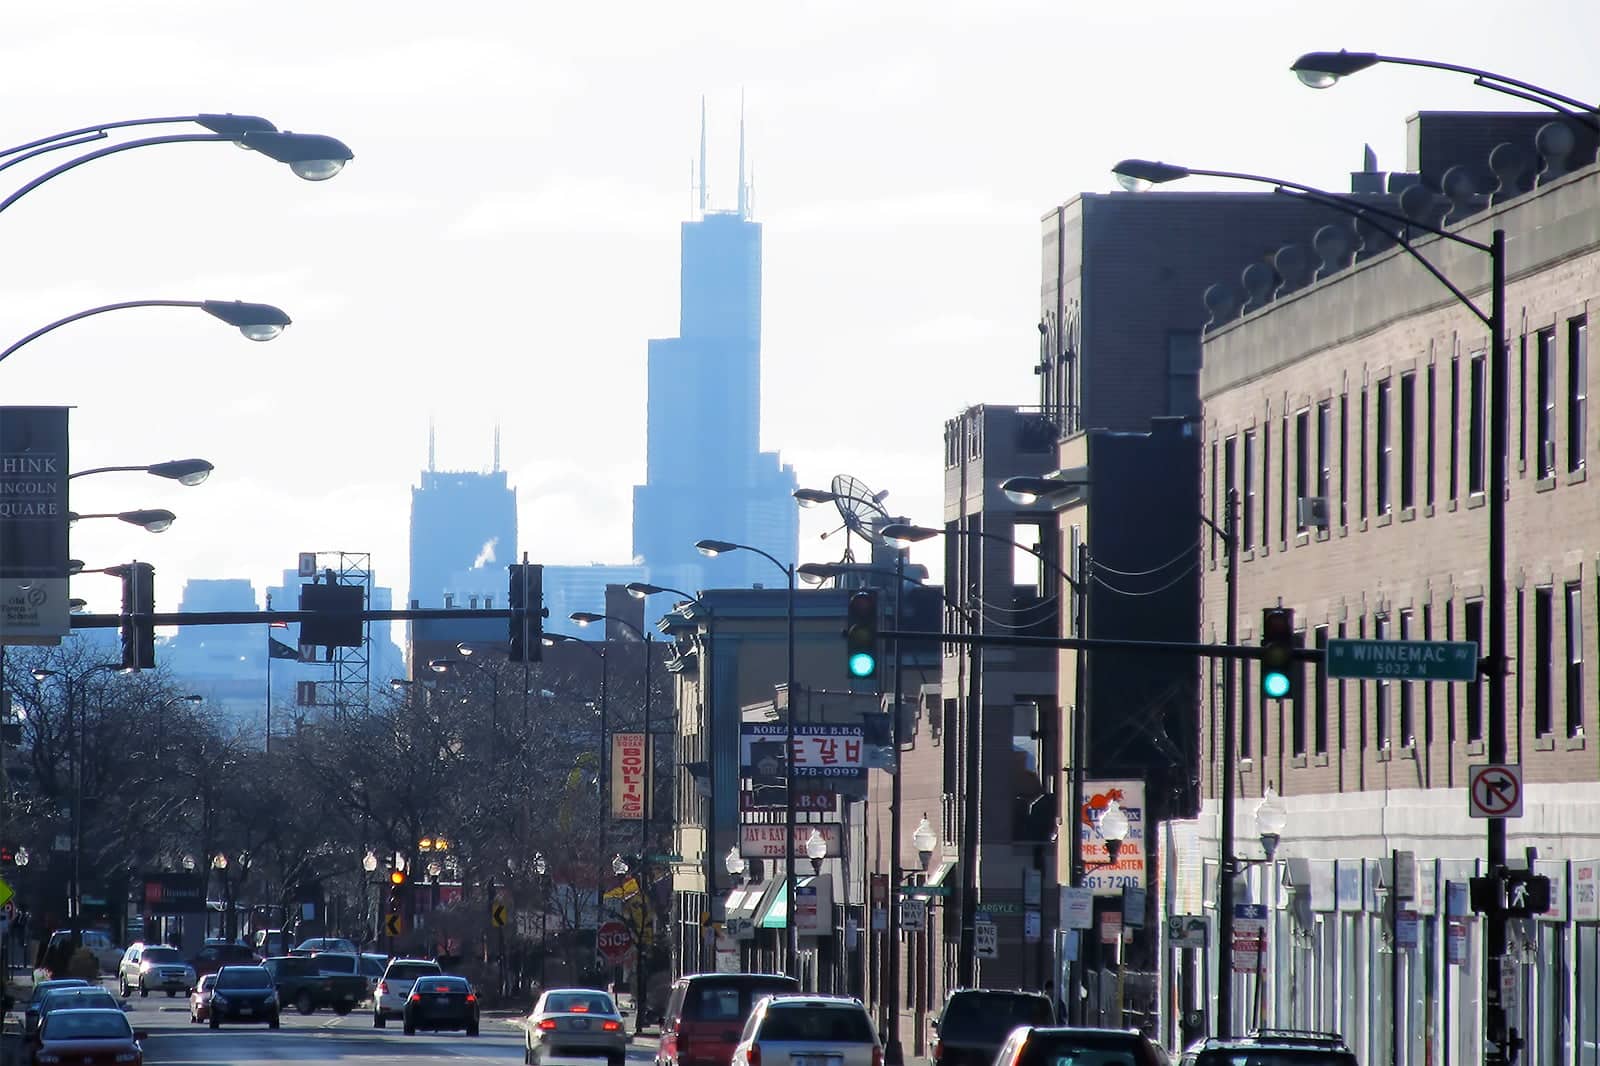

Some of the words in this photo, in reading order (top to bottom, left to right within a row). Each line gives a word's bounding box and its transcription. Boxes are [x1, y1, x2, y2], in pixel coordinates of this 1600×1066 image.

[3, 457, 57, 473] HINK
[0, 482, 57, 494] INCOLN
[0, 503, 57, 517] QUARE
[1335, 646, 1344, 657] W
[1352, 644, 1446, 662] WINNEMAC
[1456, 648, 1468, 659] AV
[1376, 663, 1410, 675] 5032
[1417, 664, 1428, 674] N
[801, 727, 827, 736] LIVE
[830, 727, 865, 738] B.B.Q.
[622, 748, 642, 812] BOWLING
[795, 794, 832, 809] .B.Q.
[745, 827, 759, 841] JAY
[769, 828, 785, 841] KAY
[1081, 876, 1139, 889] 561-7206
[904, 903, 921, 911] ONE
[980, 904, 1014, 913] ARGYLE
[904, 911, 921, 919] WAY
[977, 926, 995, 936] ONE
[599, 932, 630, 947] STOP
[977, 937, 995, 946] WAY
